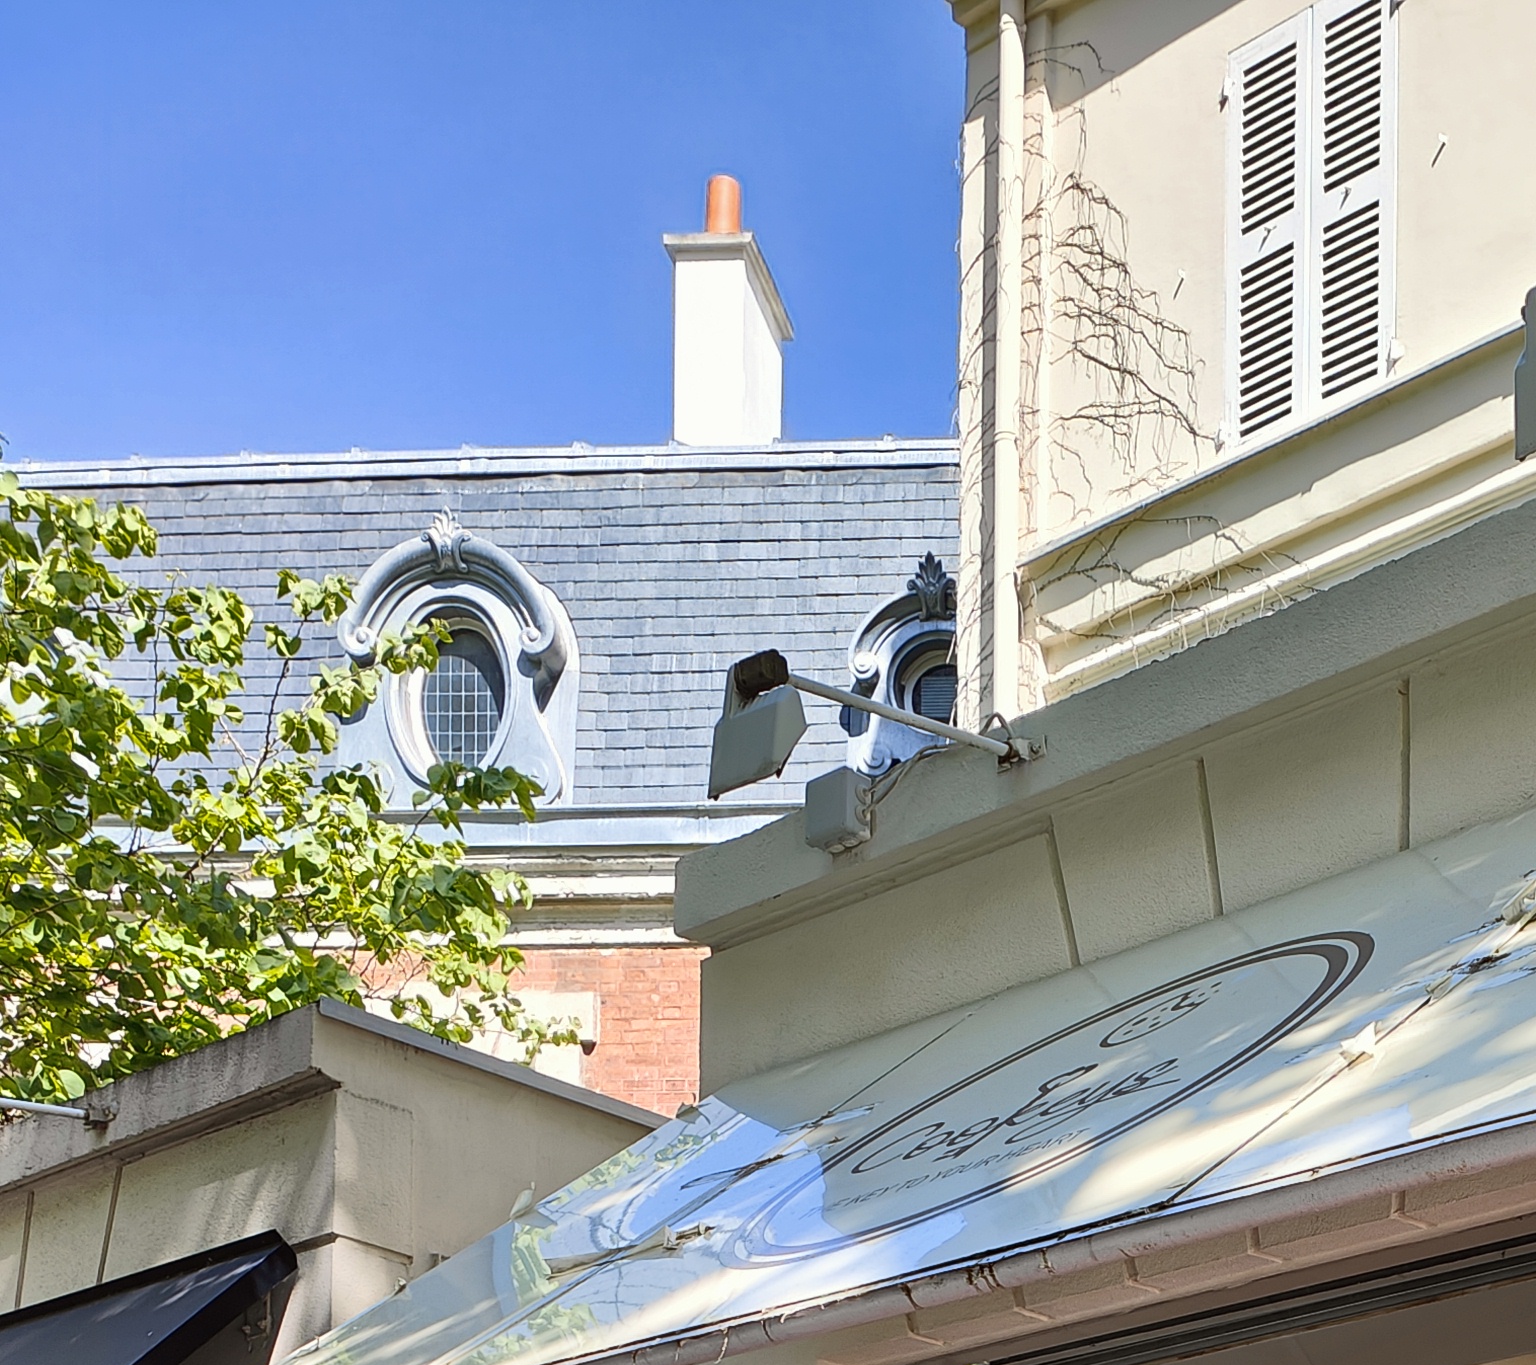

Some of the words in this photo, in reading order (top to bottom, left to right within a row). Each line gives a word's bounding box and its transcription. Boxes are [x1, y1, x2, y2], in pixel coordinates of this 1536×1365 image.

[896, 1174, 930, 1193] TO
[930, 1153, 1006, 1184] YOUR
[997, 1127, 1091, 1164] HEART
